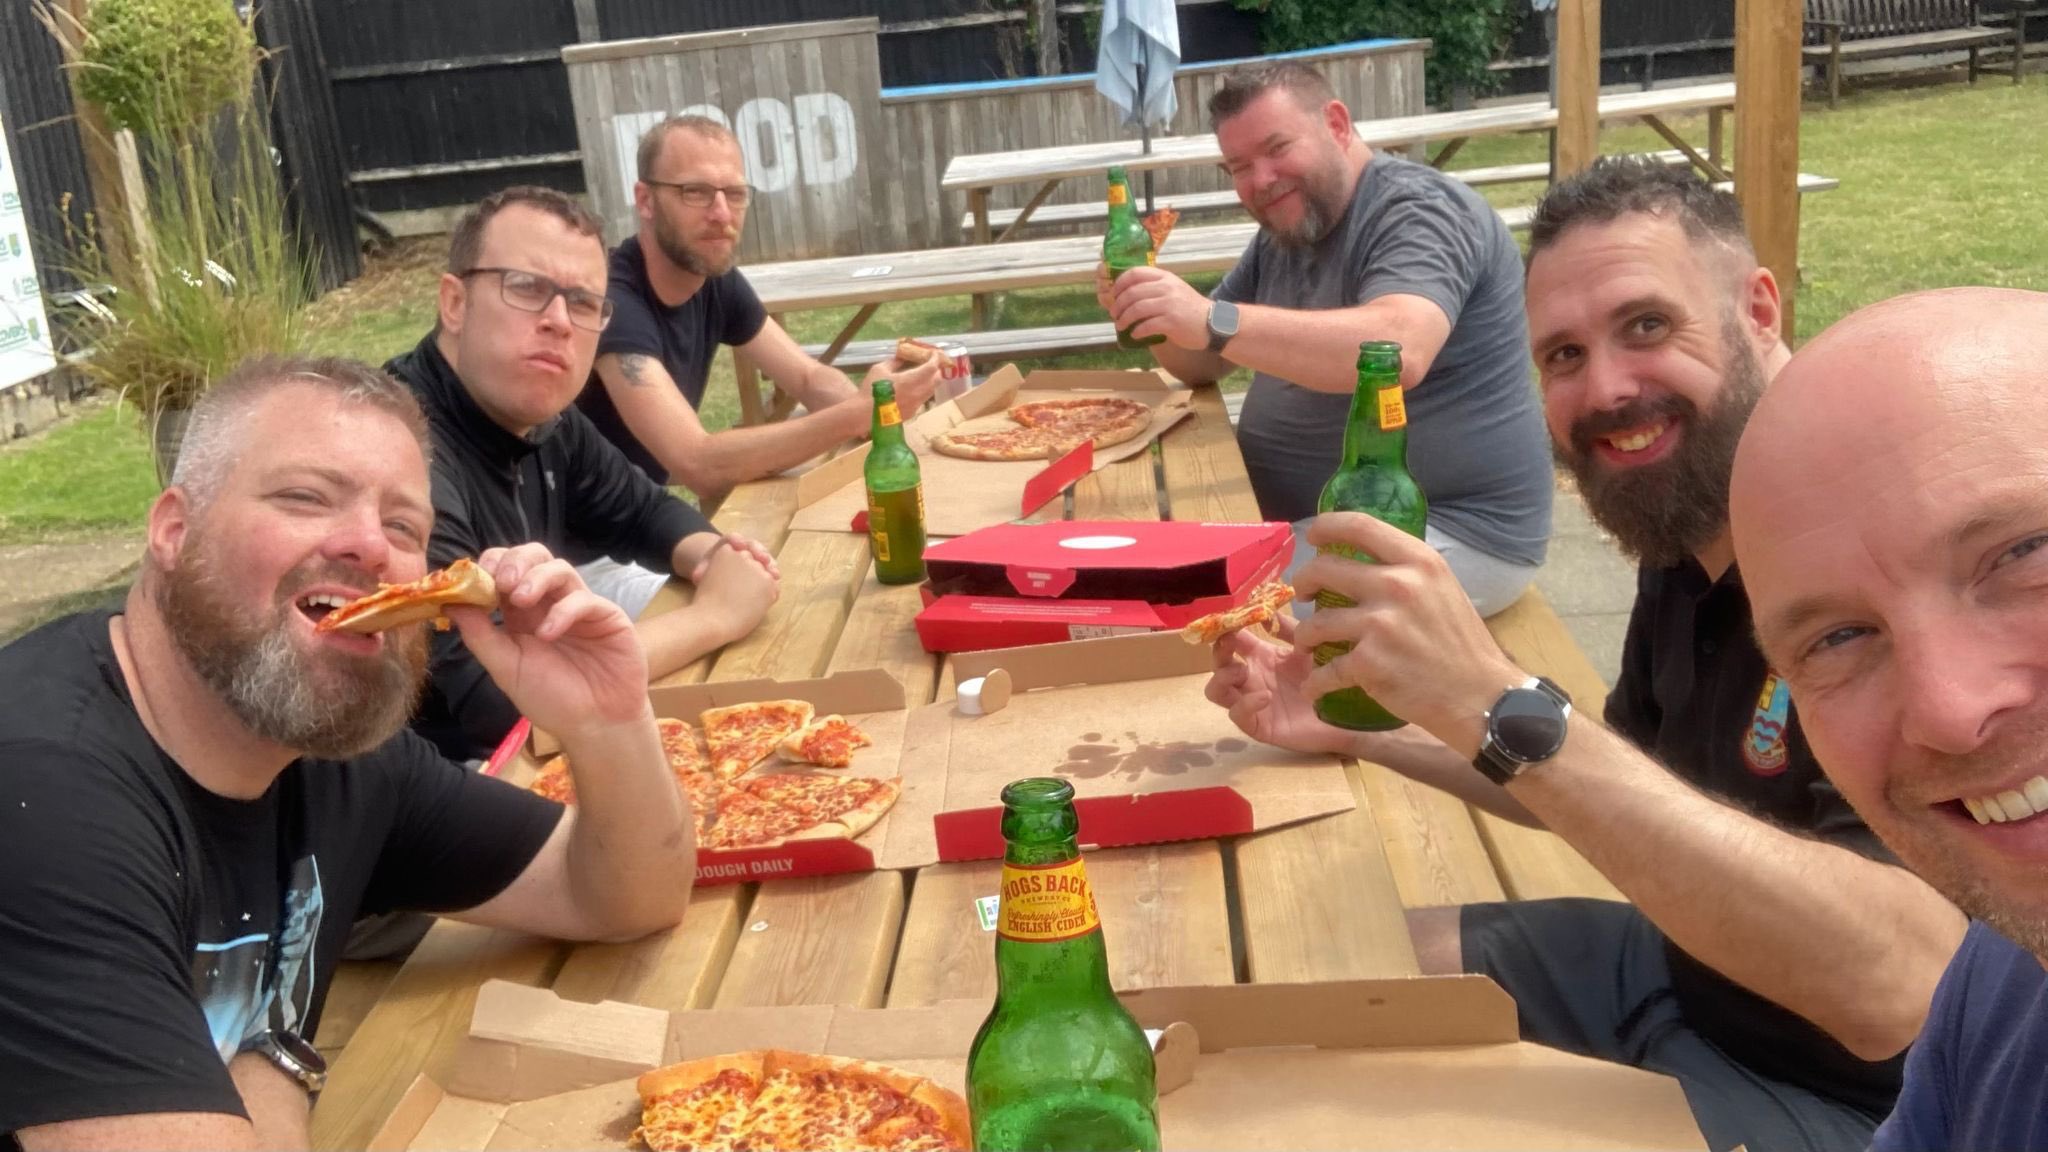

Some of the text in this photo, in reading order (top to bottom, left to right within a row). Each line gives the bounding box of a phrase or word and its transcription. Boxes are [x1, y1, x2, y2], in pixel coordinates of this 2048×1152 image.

[612, 92, 858, 206] FOD
[695, 858, 794, 879] DOUGH DAILY
[1003, 874, 1086, 902] HOGS BACK
[1008, 915, 1086, 933] ENGLISH CIDER
